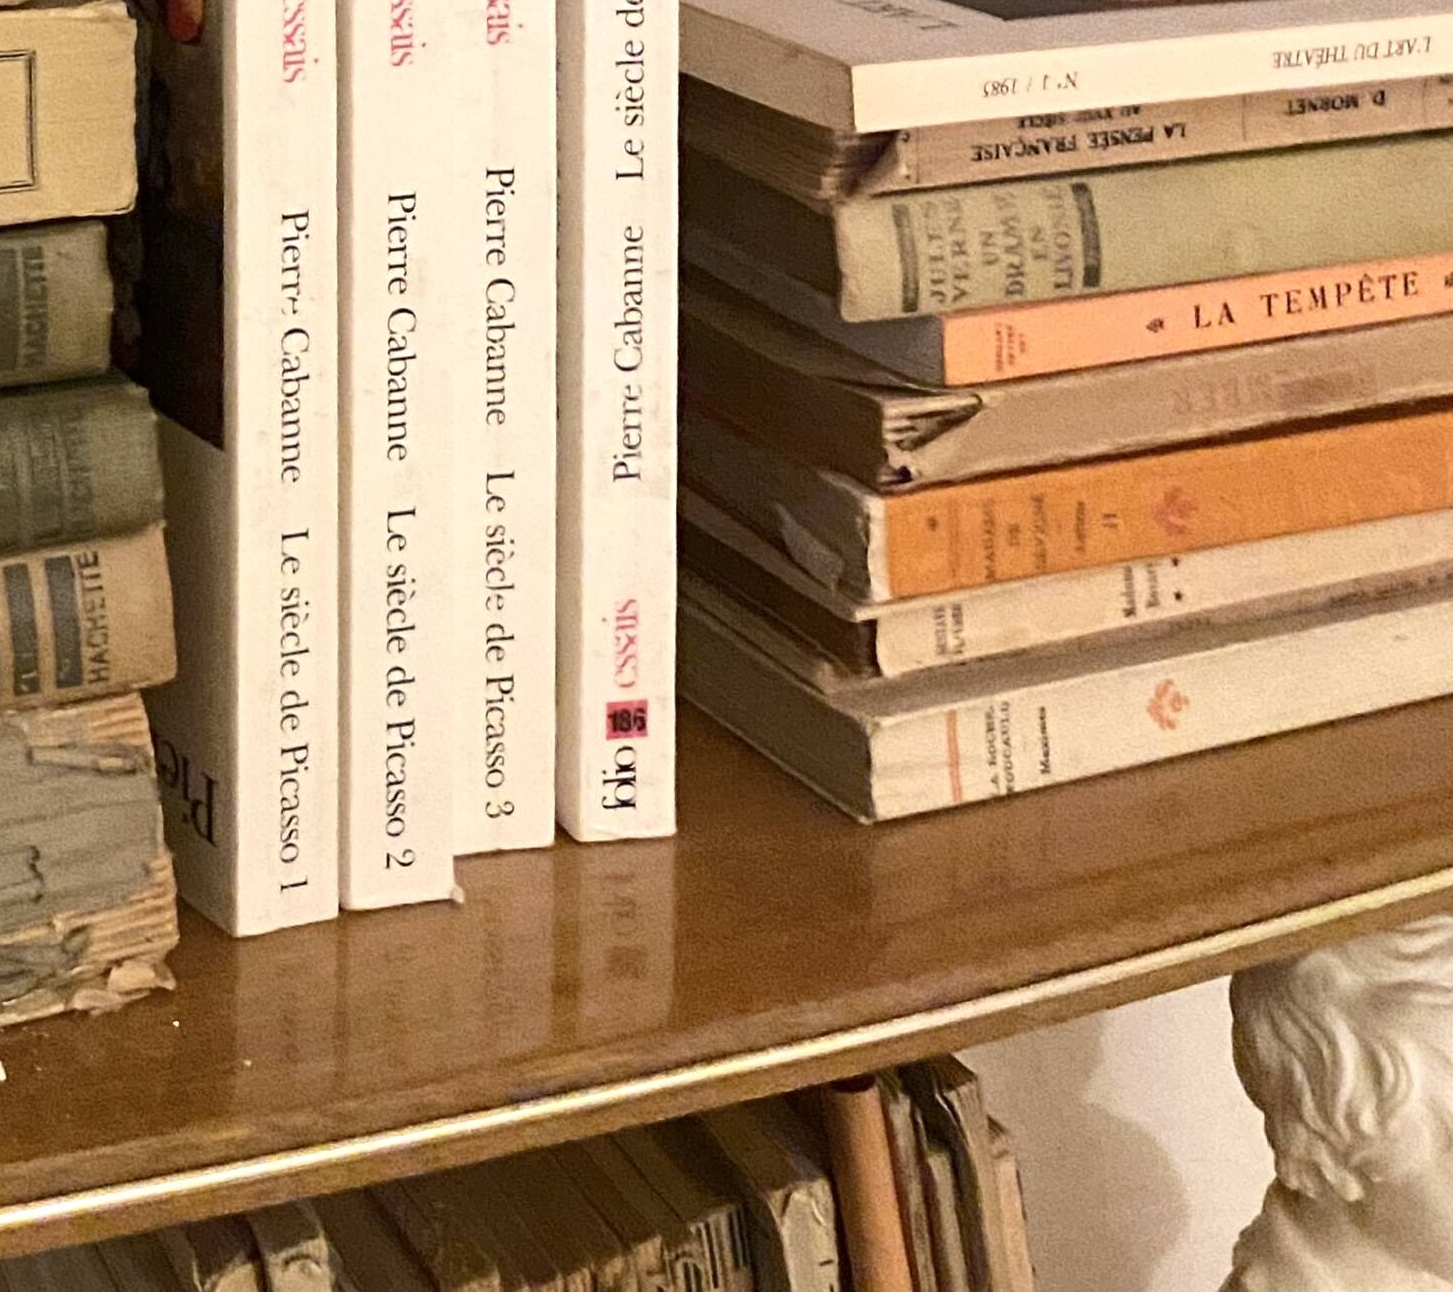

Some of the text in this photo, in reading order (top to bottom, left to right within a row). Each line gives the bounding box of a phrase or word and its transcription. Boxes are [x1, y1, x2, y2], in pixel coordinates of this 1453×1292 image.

[1353, 40, 1381, 61] DU
[1382, 35, 1433, 59] L'ART
[614, 39, 645, 127] siècle
[982, 76, 1019, 98] 1985
[1284, 94, 1360, 117] MORNET
[615, 138, 644, 181] Le
[969, 122, 1187, 163] LA PENSÉE FRANÇAISE
[980, 229, 1000, 268] UN
[613, 224, 644, 372] Cabanne
[1193, 270, 1421, 330] LA TEMPÊTE
[612, 383, 643, 482] Pierre
[485, 165, 516, 819] Pierre Cabanne Le siècle de Picasso 3
[280, 208, 311, 893] Pierre Cabanne Le siècle de Picasso 1
[385, 191, 418, 870] Pierre Cabanne Le siècle de Picasso 2
[74, 549, 112, 685] HACHETTE
[601, 598, 639, 689] essais
[602, 745, 637, 810] folio
